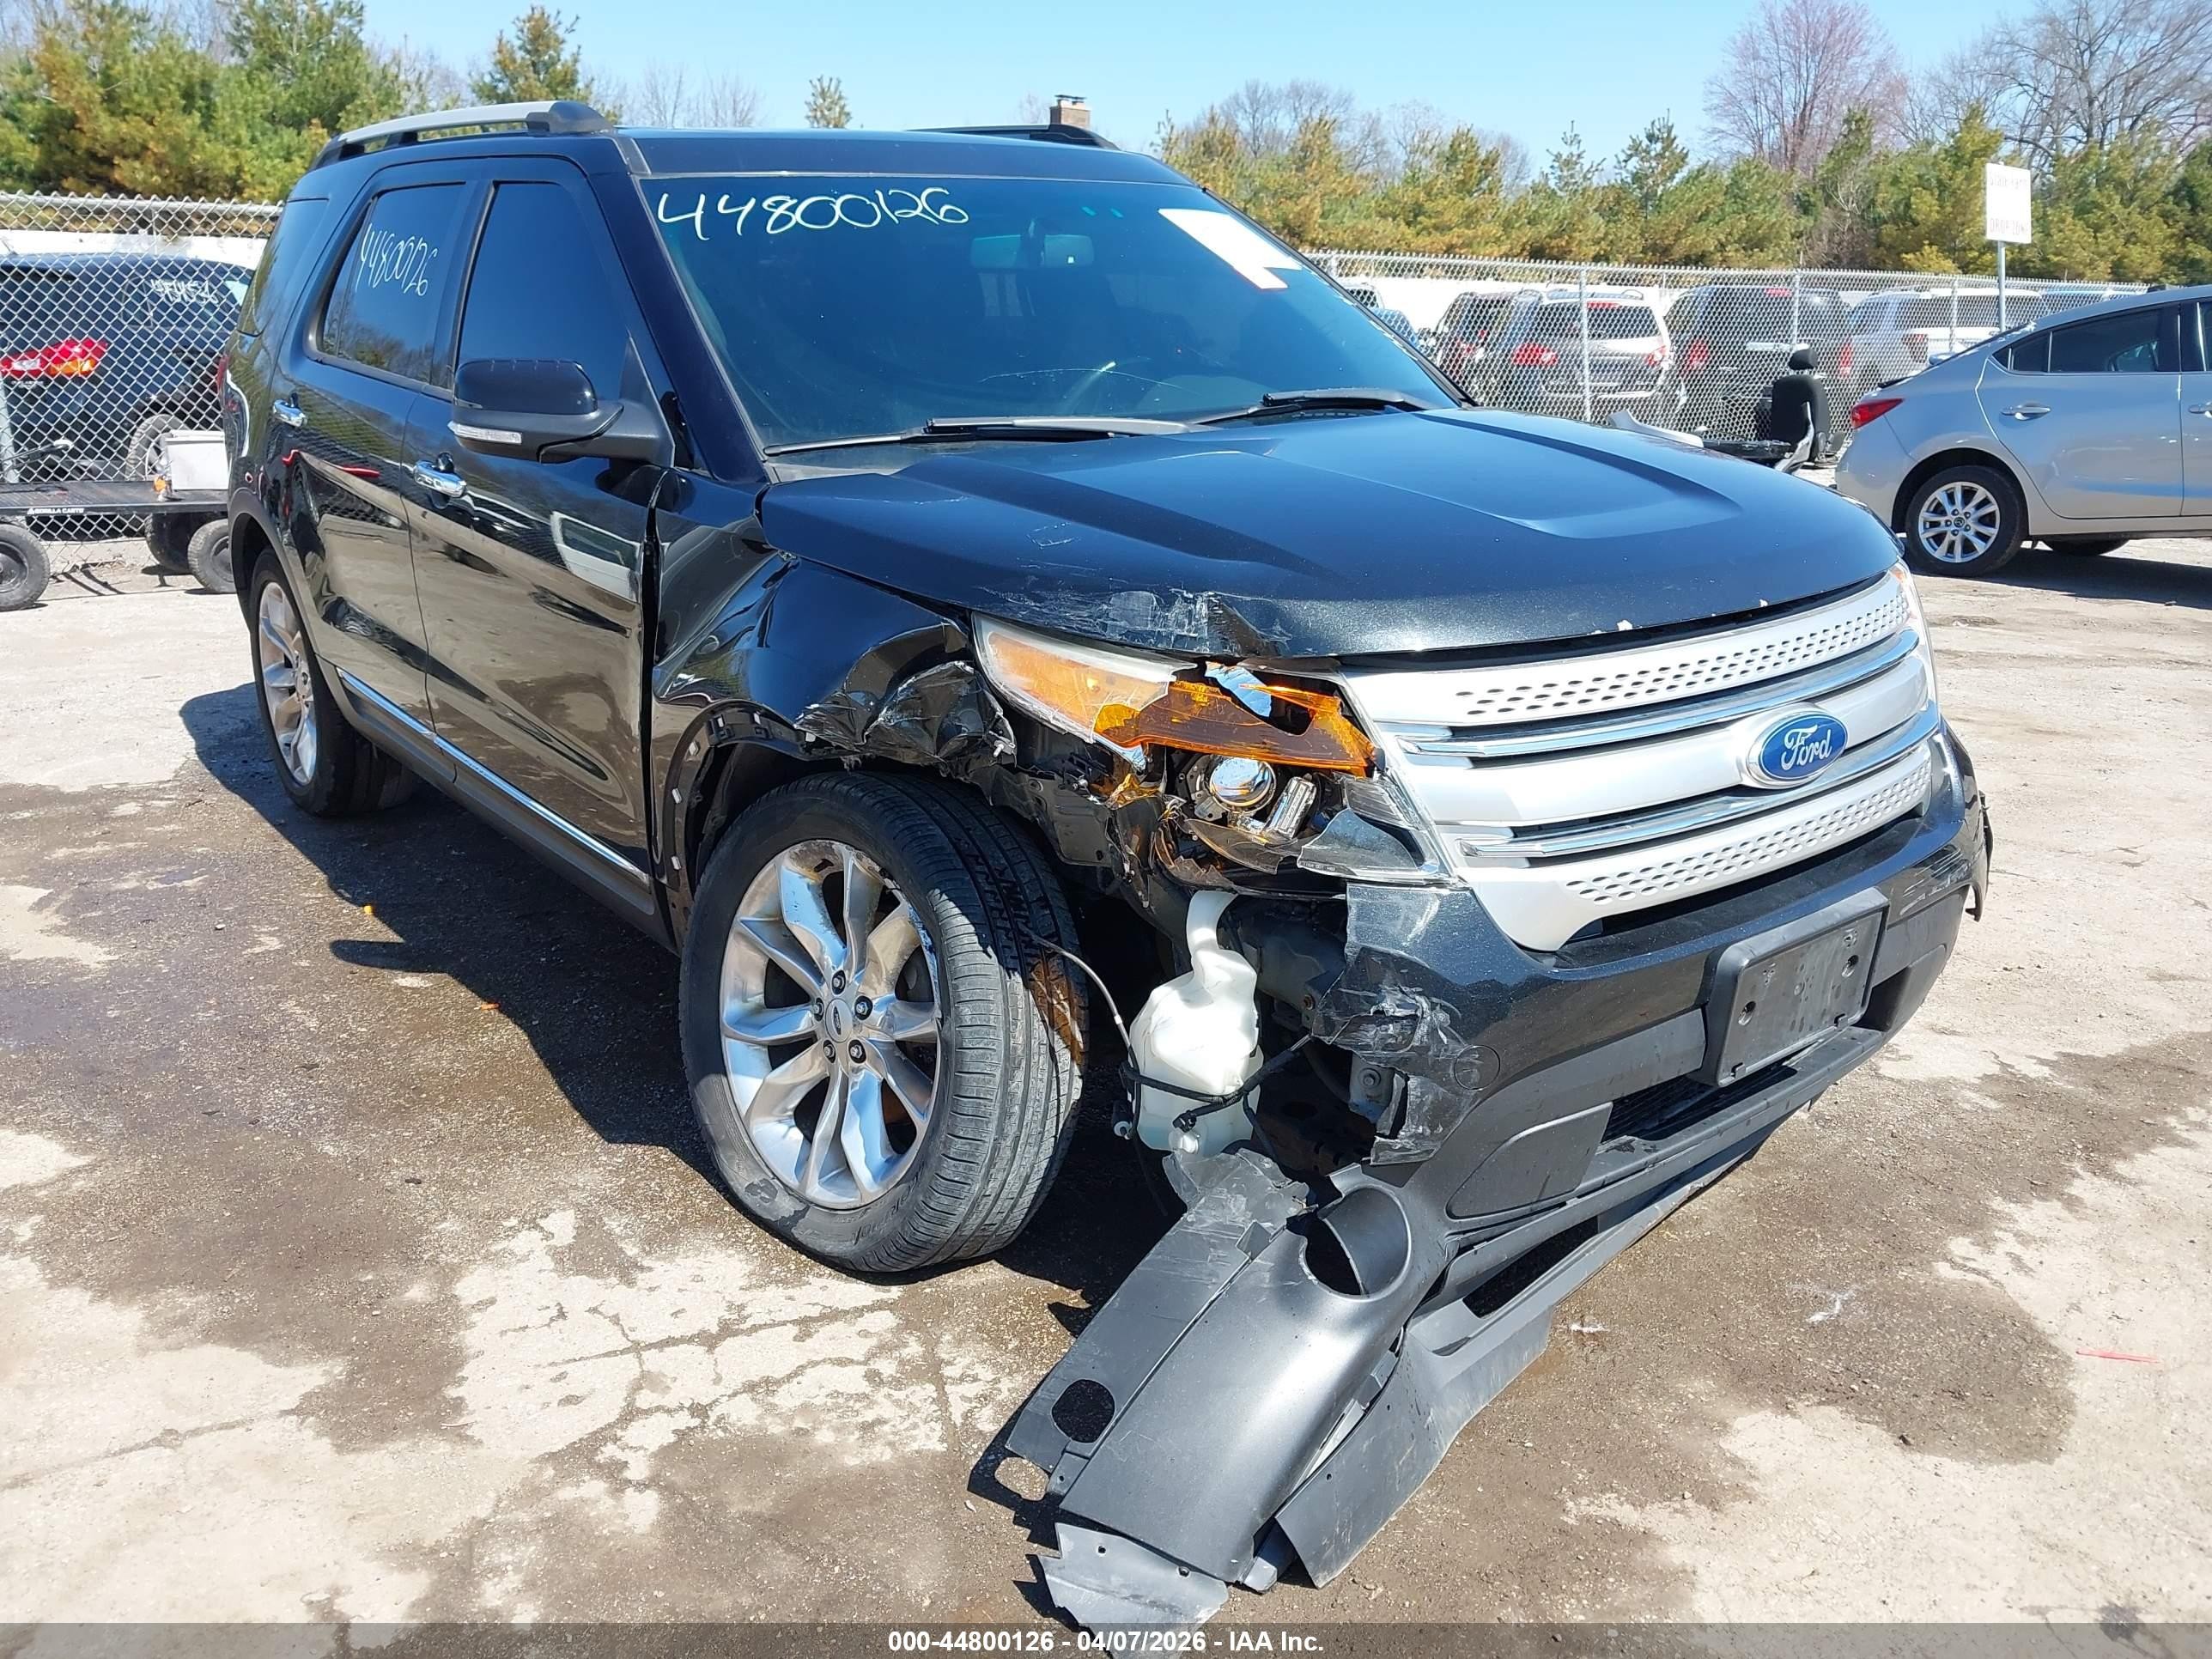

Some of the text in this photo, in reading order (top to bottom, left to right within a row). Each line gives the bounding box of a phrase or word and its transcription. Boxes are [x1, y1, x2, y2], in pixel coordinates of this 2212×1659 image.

[658, 186, 969, 241] 44800126
[355, 222, 438, 296] 44800126
[1780, 724, 1832, 770] Ford
